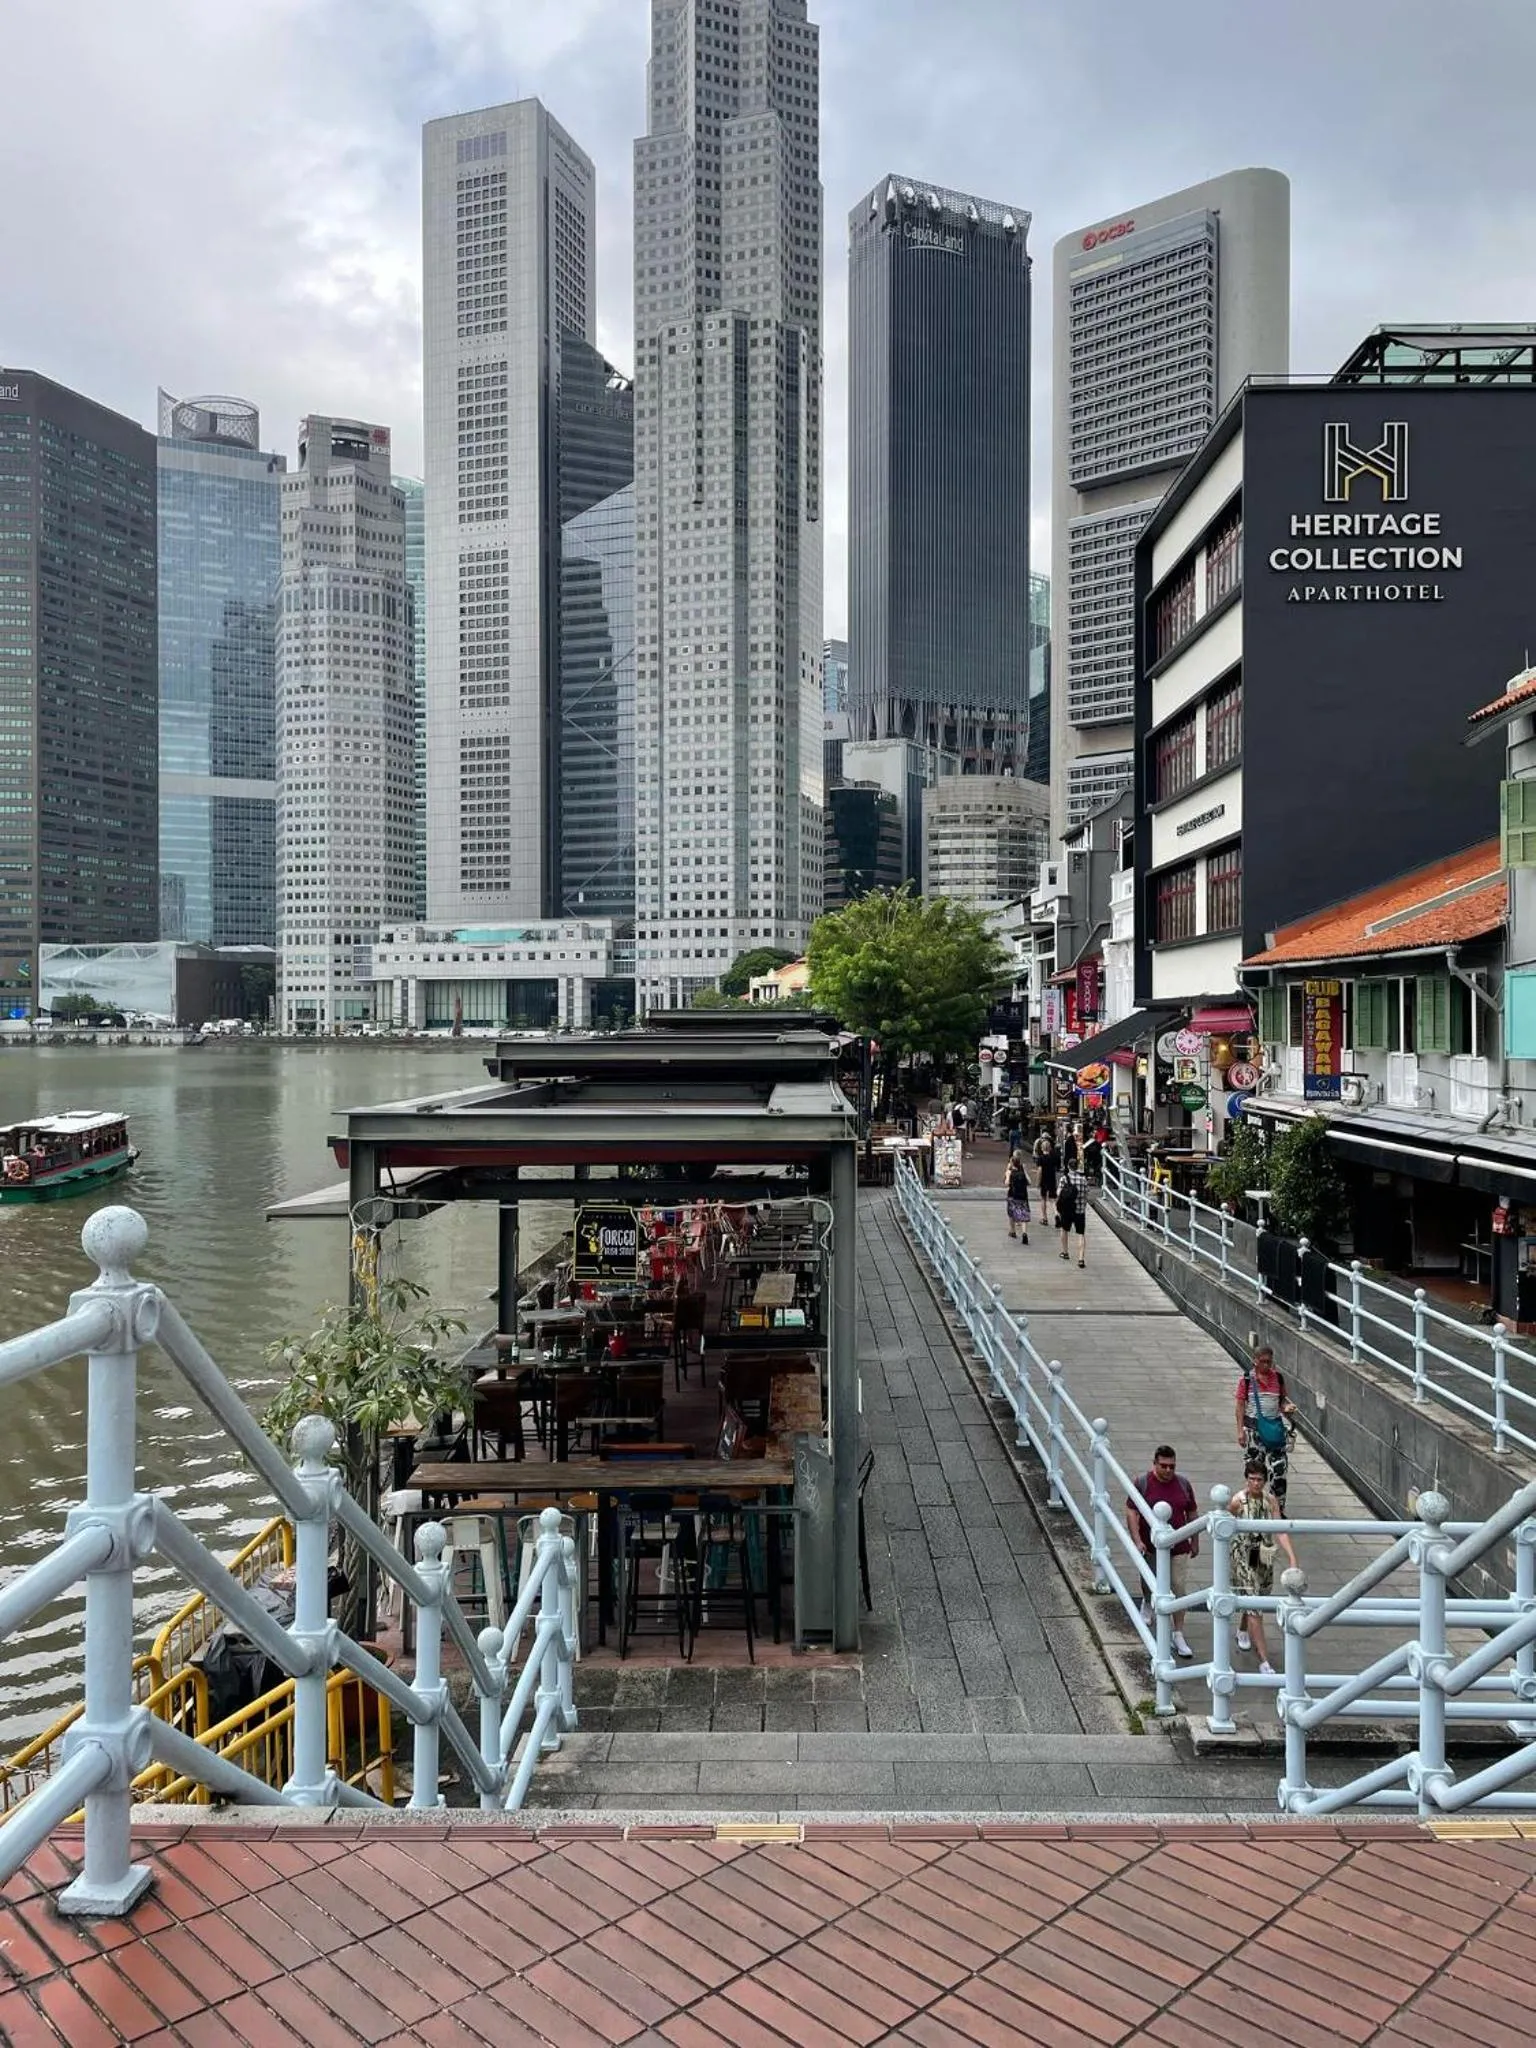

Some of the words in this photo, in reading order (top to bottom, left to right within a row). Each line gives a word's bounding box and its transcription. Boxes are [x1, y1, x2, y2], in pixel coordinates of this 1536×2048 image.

[903, 221, 964, 252] CapitaLand
[1098, 219, 1135, 243] OCBC
[1290, 513, 1441, 536] HERITAGE
[1269, 547, 1463, 571] COLLECTION
[1288, 585, 1445, 601] APARTHOTEL
[1305, 981, 1339, 996] CLUB
